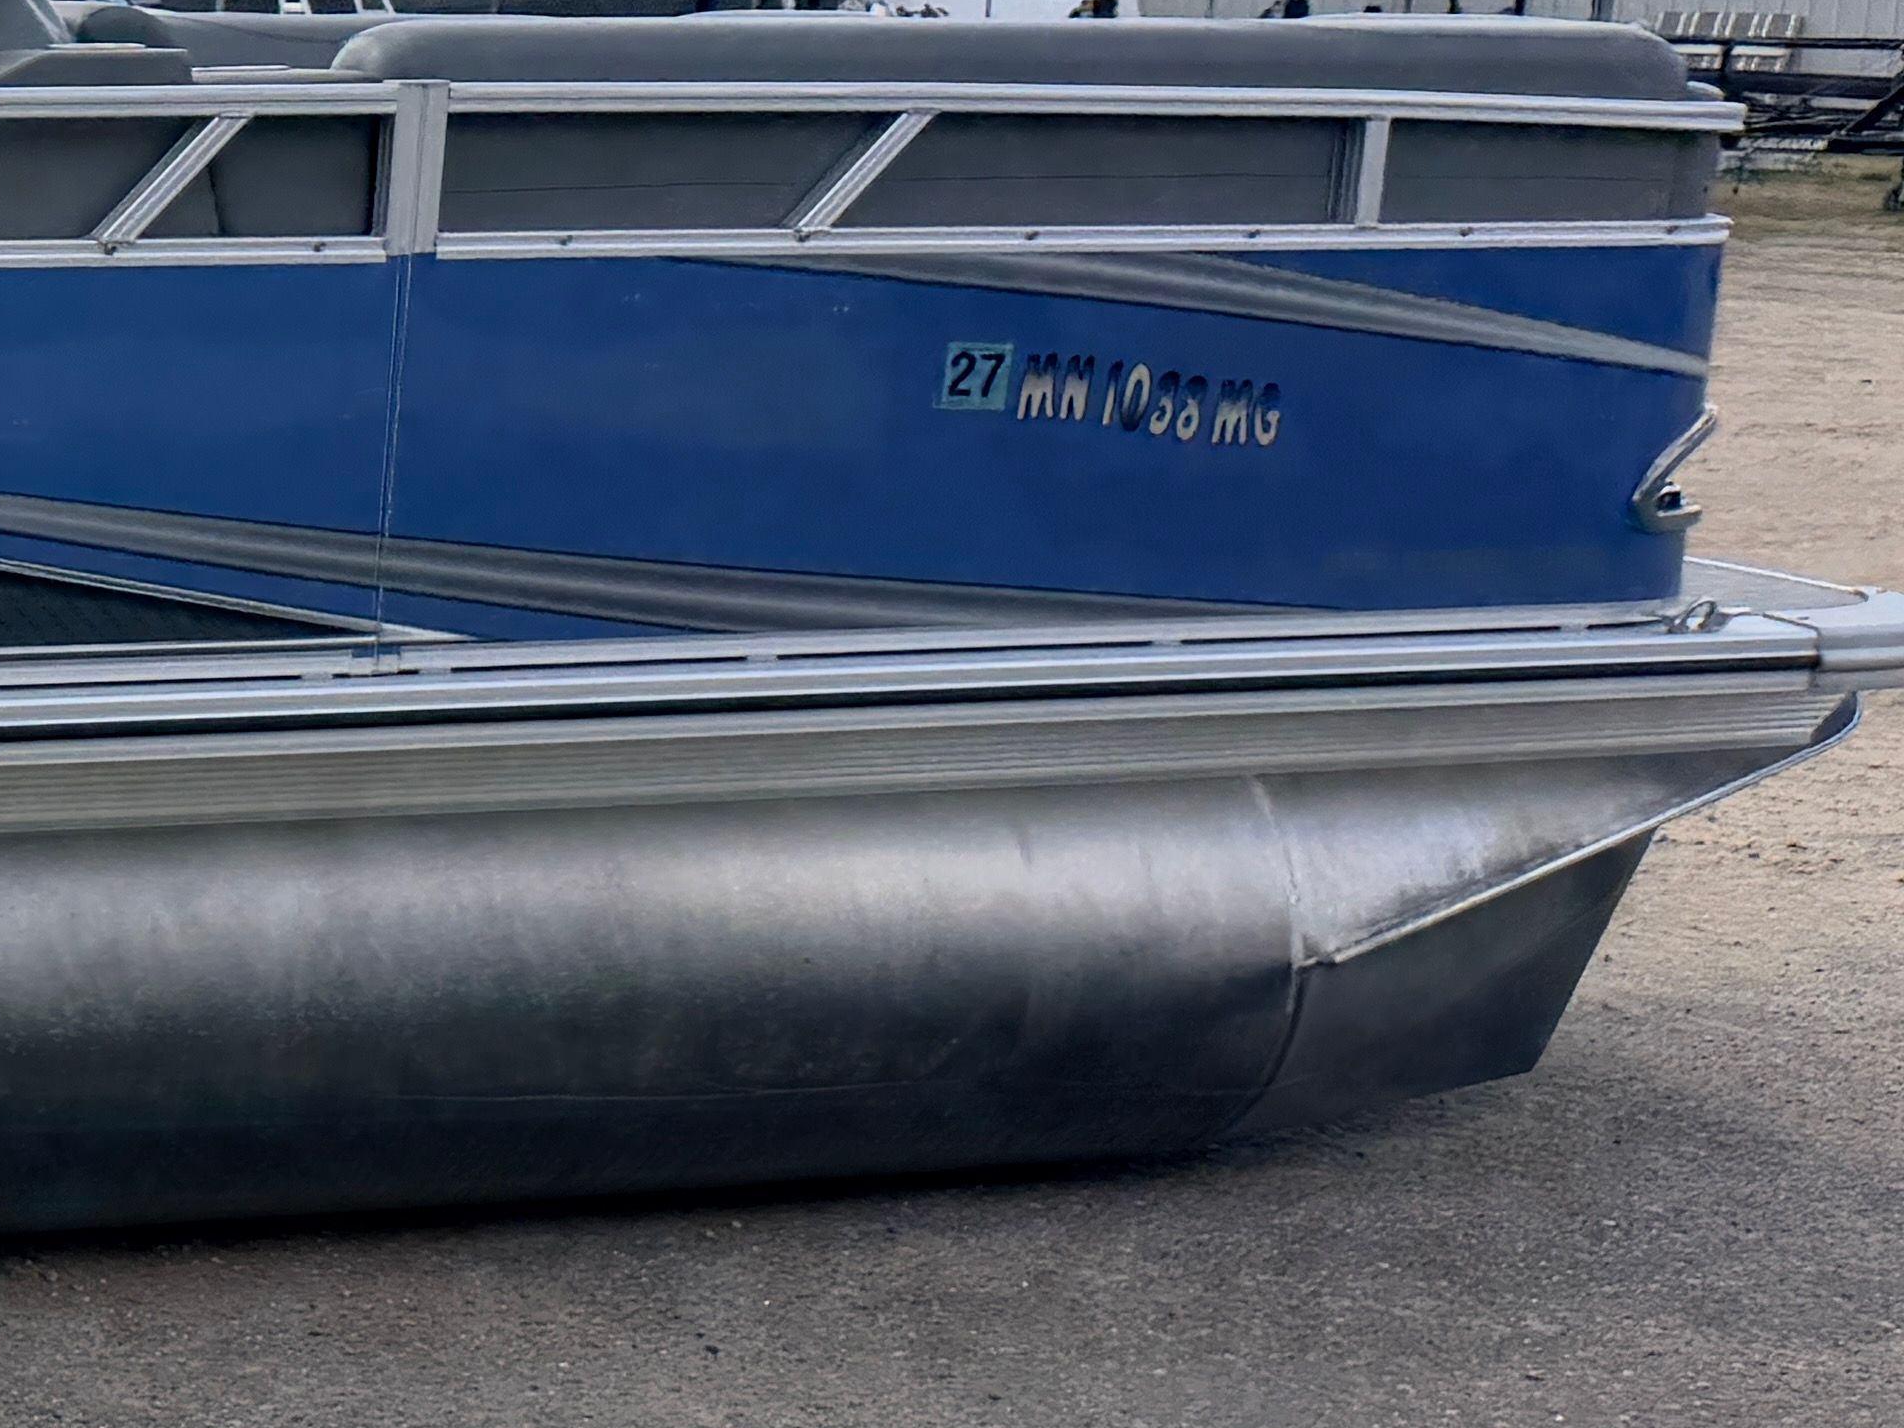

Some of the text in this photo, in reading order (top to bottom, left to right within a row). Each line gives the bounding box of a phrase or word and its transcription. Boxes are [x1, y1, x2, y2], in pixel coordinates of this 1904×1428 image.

[948, 351, 1005, 398] 27
[1017, 352, 1095, 421] MN
[1211, 378, 1281, 445] MG
